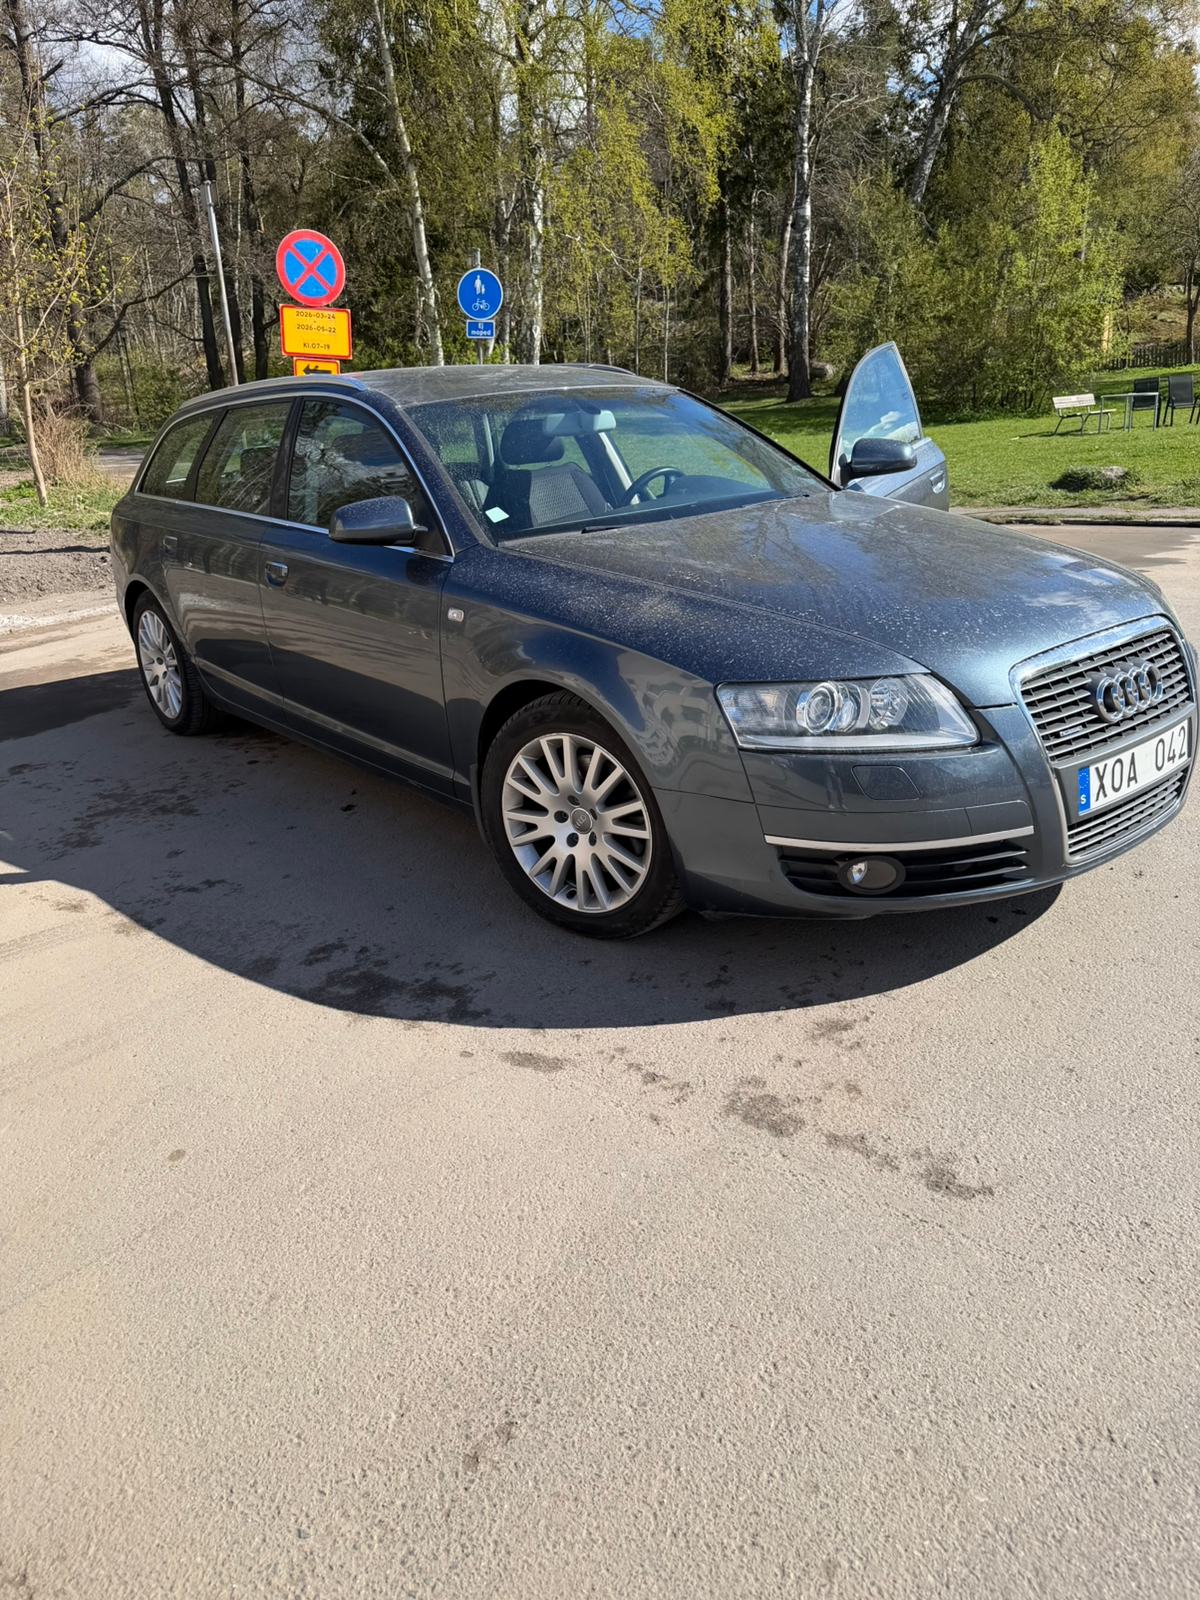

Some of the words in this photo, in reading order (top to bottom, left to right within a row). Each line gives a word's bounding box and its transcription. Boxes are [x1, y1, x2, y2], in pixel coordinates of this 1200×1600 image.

[296, 311, 336, 320] 2026-03-24
[296, 324, 337, 333] 2026-05-22
[470, 329, 492, 337] moped
[1080, 794, 1087, 805] S
[1094, 751, 1138, 802] XOA
[1154, 725, 1186, 772] 042
